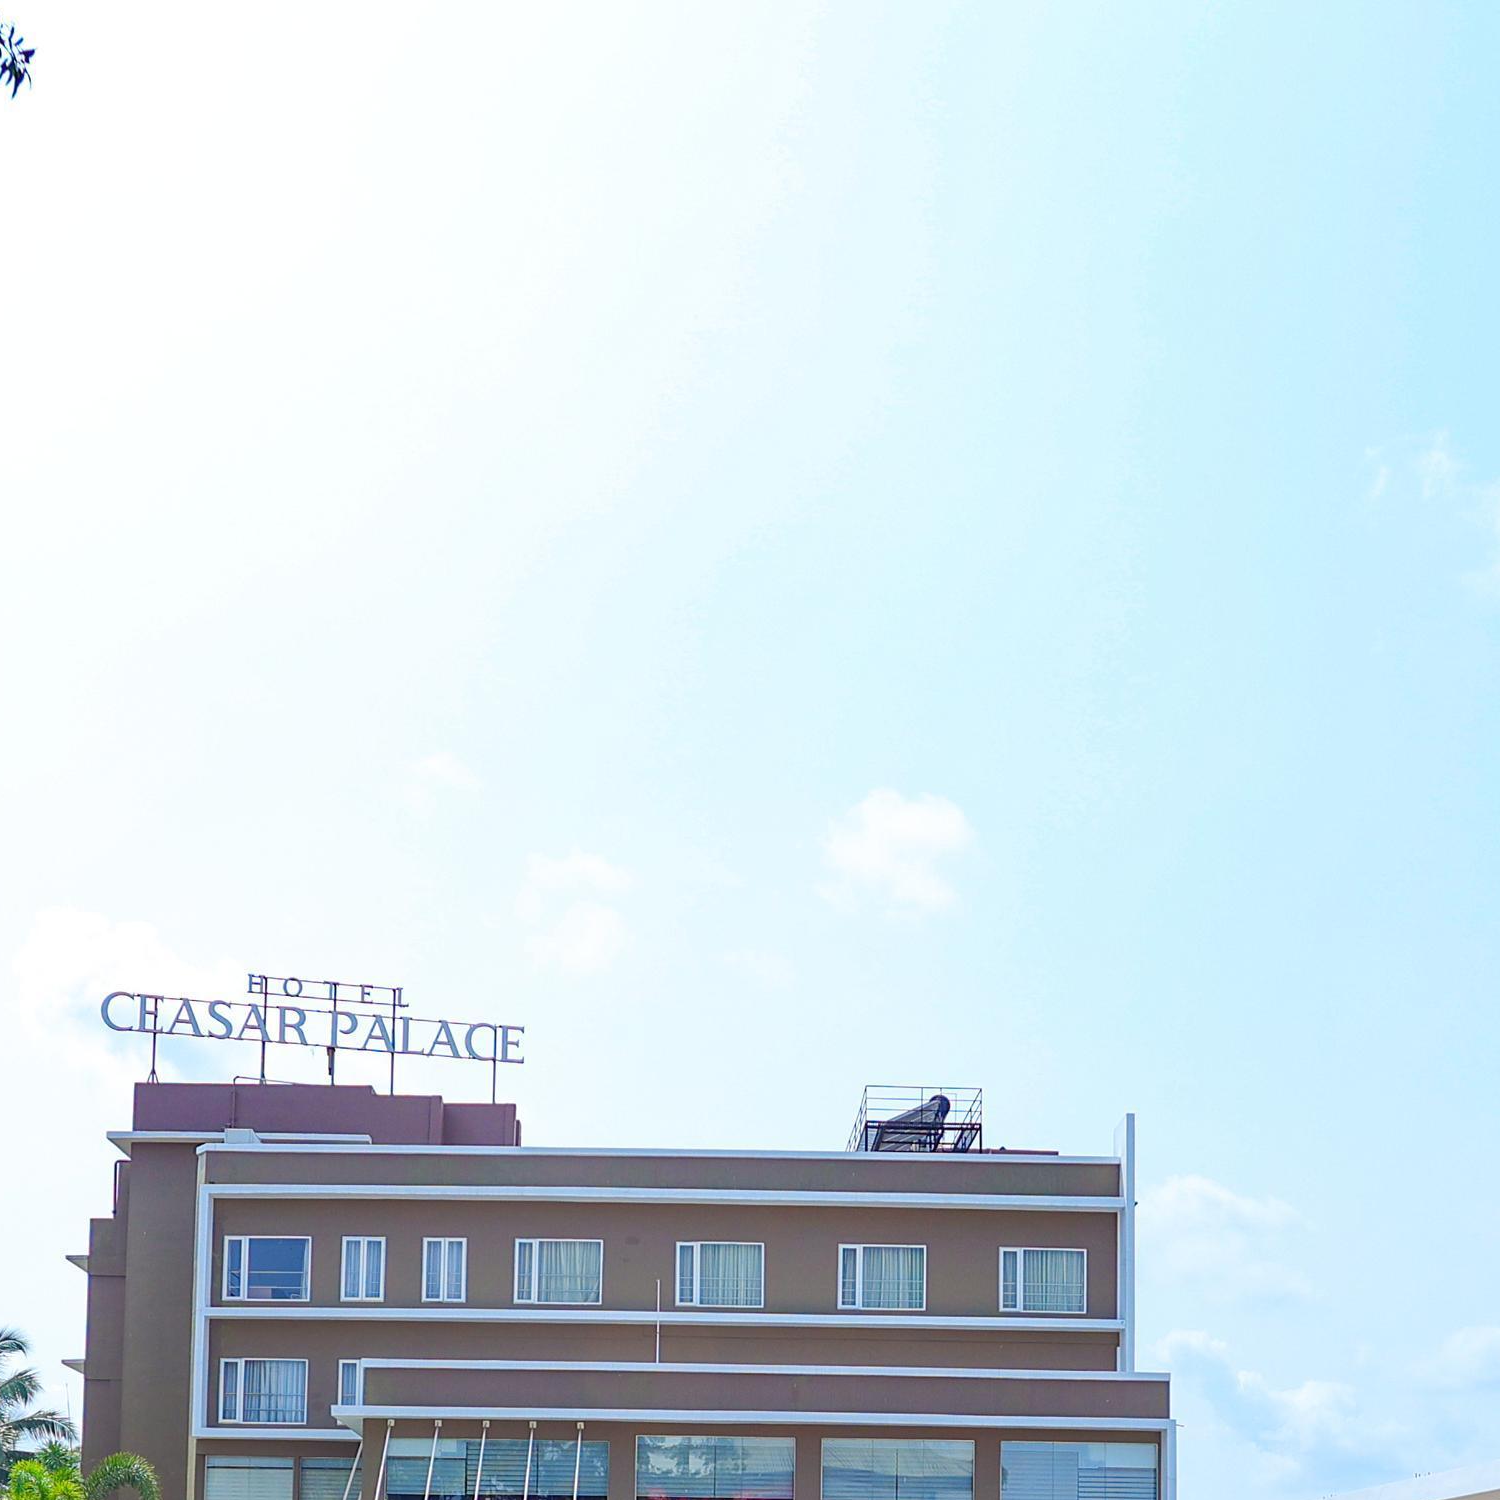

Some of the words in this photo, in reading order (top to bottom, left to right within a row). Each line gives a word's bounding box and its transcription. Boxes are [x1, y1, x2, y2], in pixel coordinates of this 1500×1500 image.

[247, 973, 409, 1008] HOTEL
[100, 991, 308, 1045] CEASAR
[330, 1011, 525, 1064] PALACE
